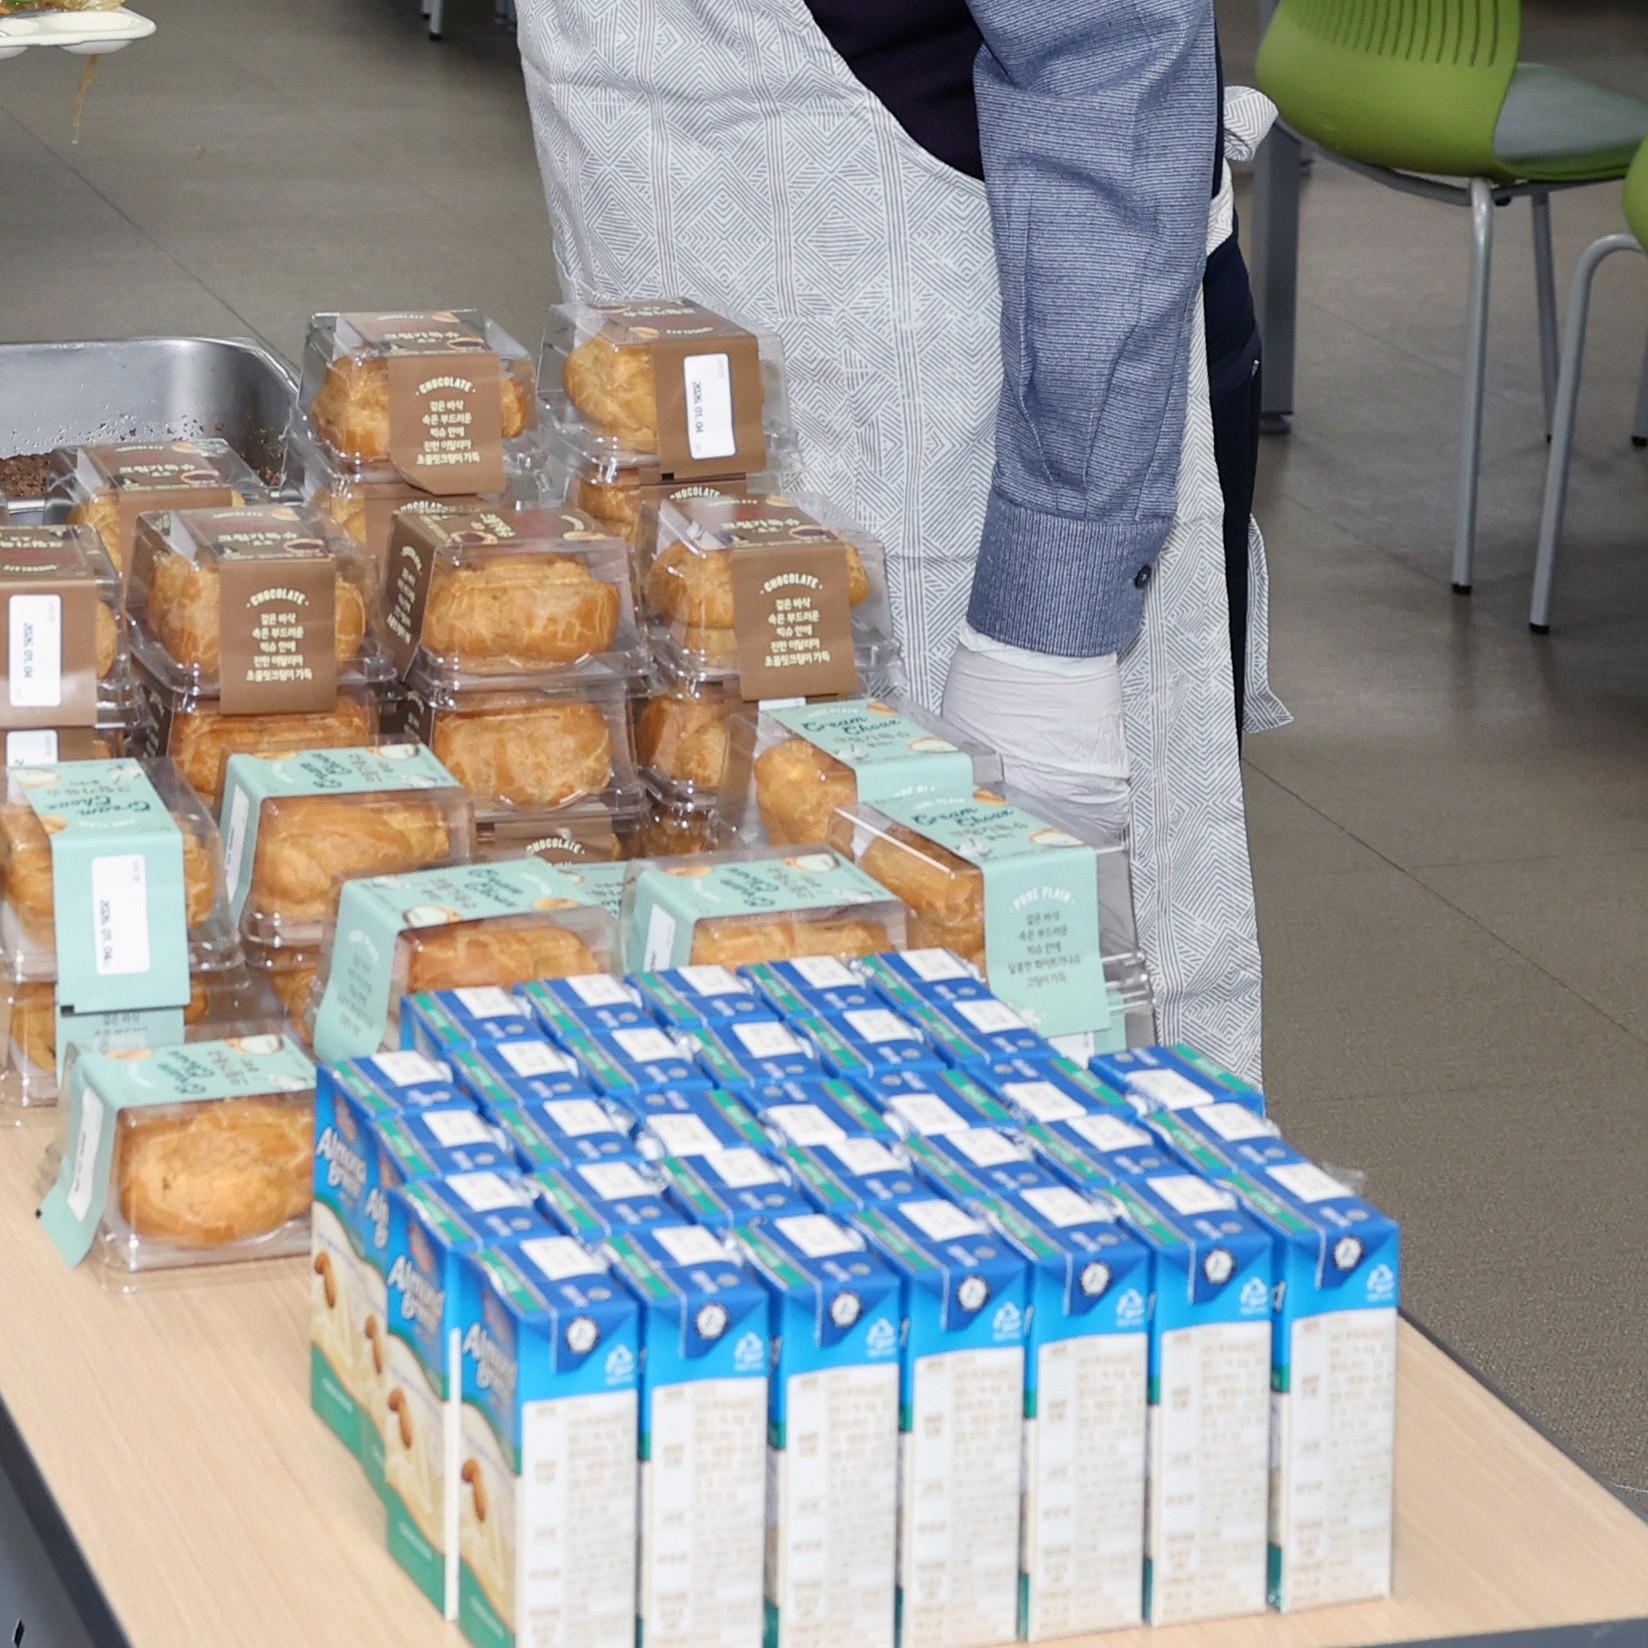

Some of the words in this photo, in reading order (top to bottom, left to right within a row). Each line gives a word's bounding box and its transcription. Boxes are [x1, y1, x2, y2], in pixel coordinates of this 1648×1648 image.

[419, 376, 473, 394] CHOCOLATE
[764, 573, 819, 593] CHOCOLATE
[250, 587, 305, 606] CHOCOLATE
[801, 716, 868, 732] Cream
[911, 807, 978, 826] Cream
